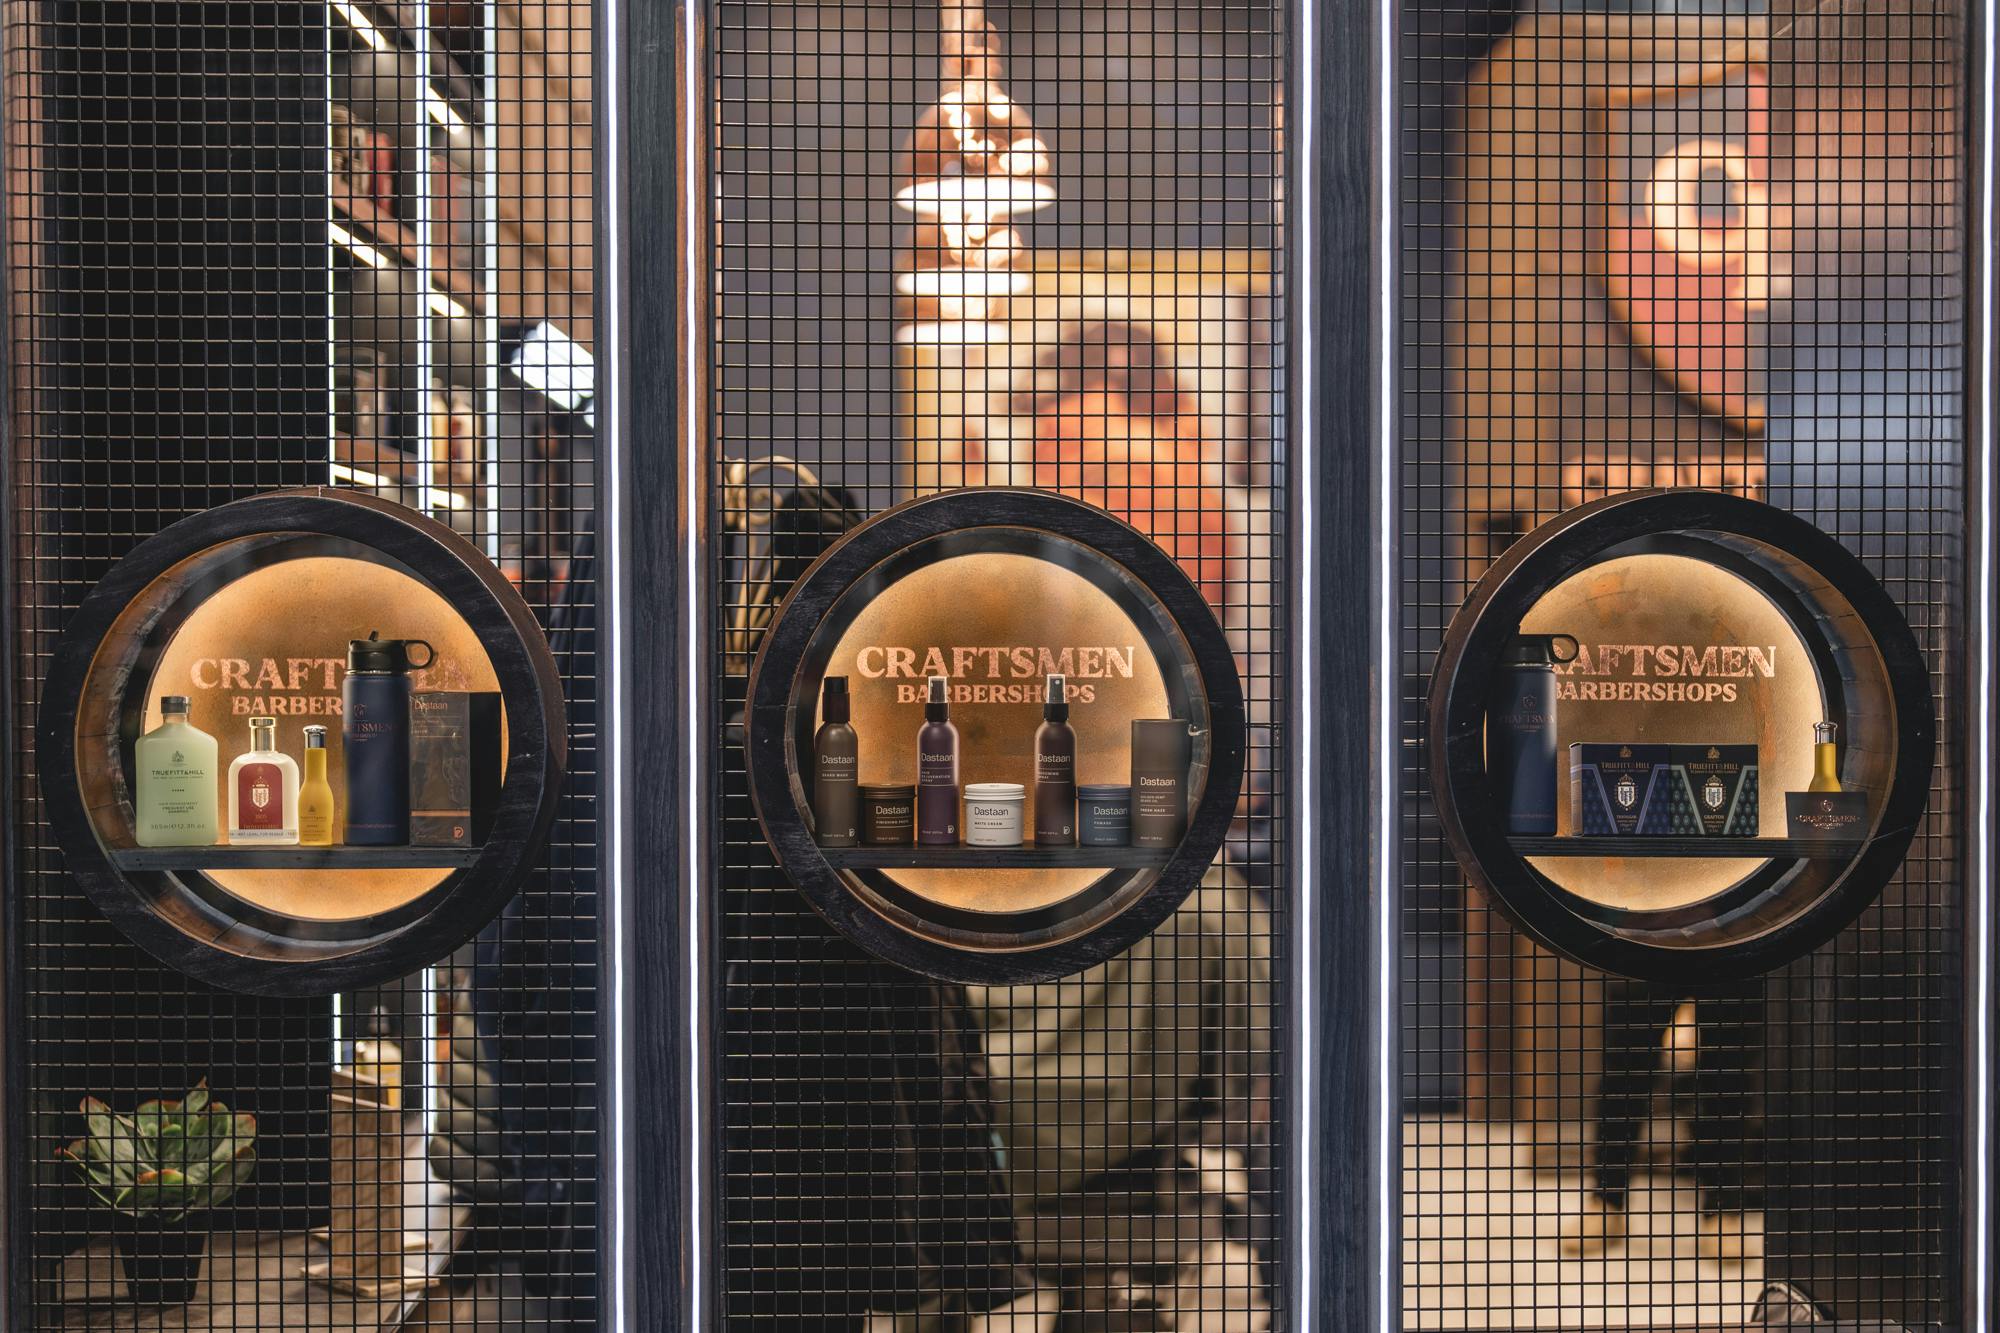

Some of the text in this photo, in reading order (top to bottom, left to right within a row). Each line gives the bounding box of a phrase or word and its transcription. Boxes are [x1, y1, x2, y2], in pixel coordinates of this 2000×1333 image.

[856, 646, 1135, 679] CRAFTSMEN
[1552, 645, 1777, 678] AFTSMEN
[897, 684, 1096, 704] BABERSHPS
[232, 696, 343, 716] BARBER
[821, 754, 855, 765] Dastaan
[921, 752, 954, 763] Dastaan
[1037, 753, 1071, 763] Dastaan
[1140, 776, 1176, 786] Dastaan
[876, 805, 909, 815] Dastaan
[974, 806, 1009, 816] Dastaan
[1094, 806, 1128, 816] Dastaan
